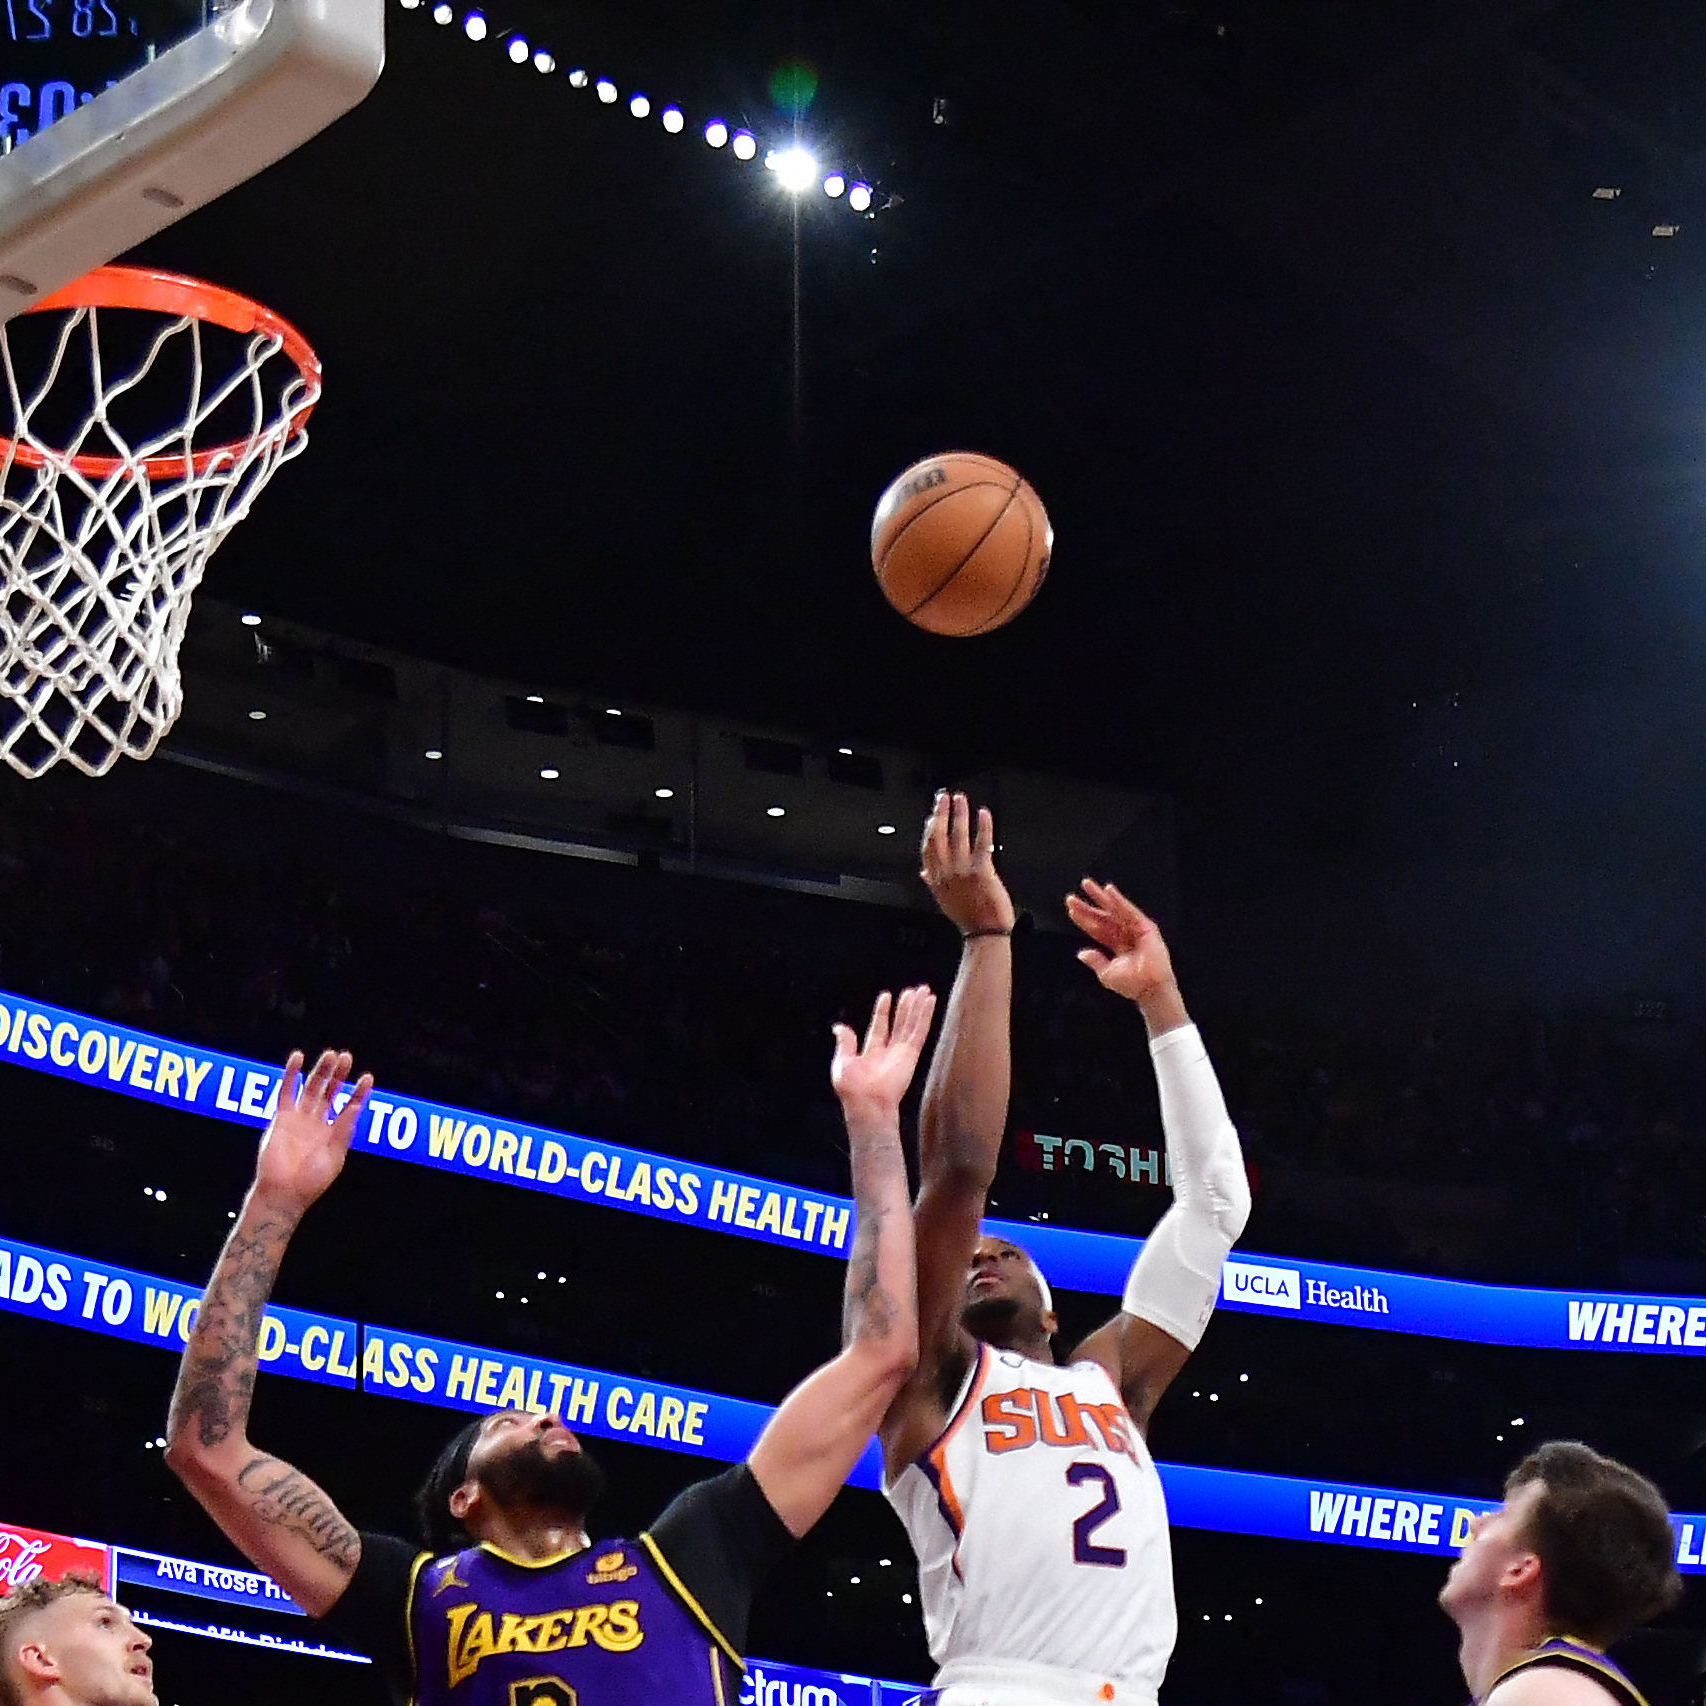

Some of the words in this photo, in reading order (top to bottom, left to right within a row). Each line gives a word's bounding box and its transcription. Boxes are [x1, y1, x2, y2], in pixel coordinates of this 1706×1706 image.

[368, 1100, 417, 1150] TO
[429, 1114, 703, 1214] WORLD-CLASS
[708, 1181, 851, 1249] HEALTH
[1233, 1272, 1290, 1299] UCLA
[1306, 1280, 1389, 1314] Health
[82, 1271, 133, 1325] TO
[144, 1287, 438, 1393] WOD-CLASS
[447, 1354, 598, 1424] HEALTH
[607, 1387, 710, 1446] CARE
[1065, 1463, 1127, 1568] 2
[1310, 1490, 1442, 1545] WHERE
[445, 1600, 644, 1689] LAKERS
